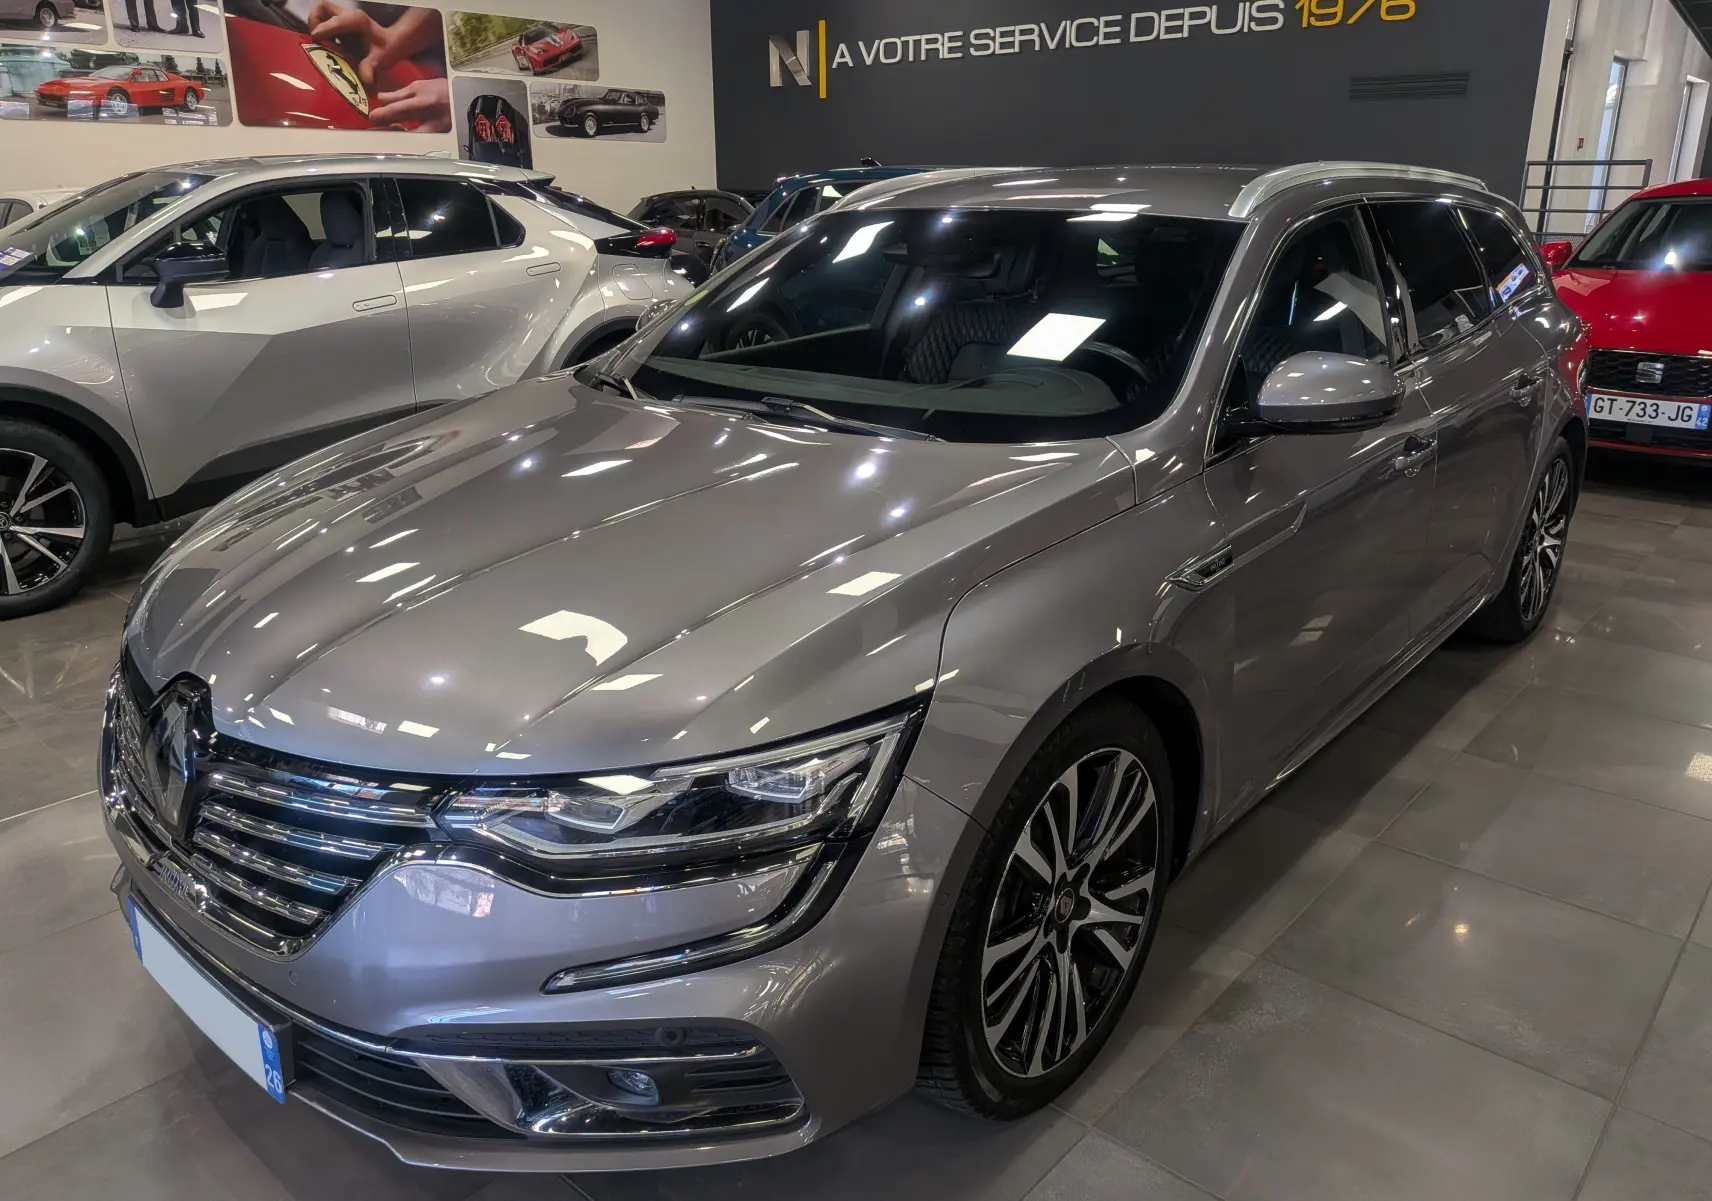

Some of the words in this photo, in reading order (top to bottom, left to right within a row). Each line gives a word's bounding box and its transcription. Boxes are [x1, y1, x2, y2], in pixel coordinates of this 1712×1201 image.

[831, 43, 854, 69] A
[858, 31, 963, 66] VOTRE
[969, 15, 1123, 57] SERVICE
[1129, 0, 1285, 43] DEPUIS
[768, 30, 812, 87] N
[1593, 397, 1693, 422] GT-733-JG
[265, 1063, 283, 1093] 26
